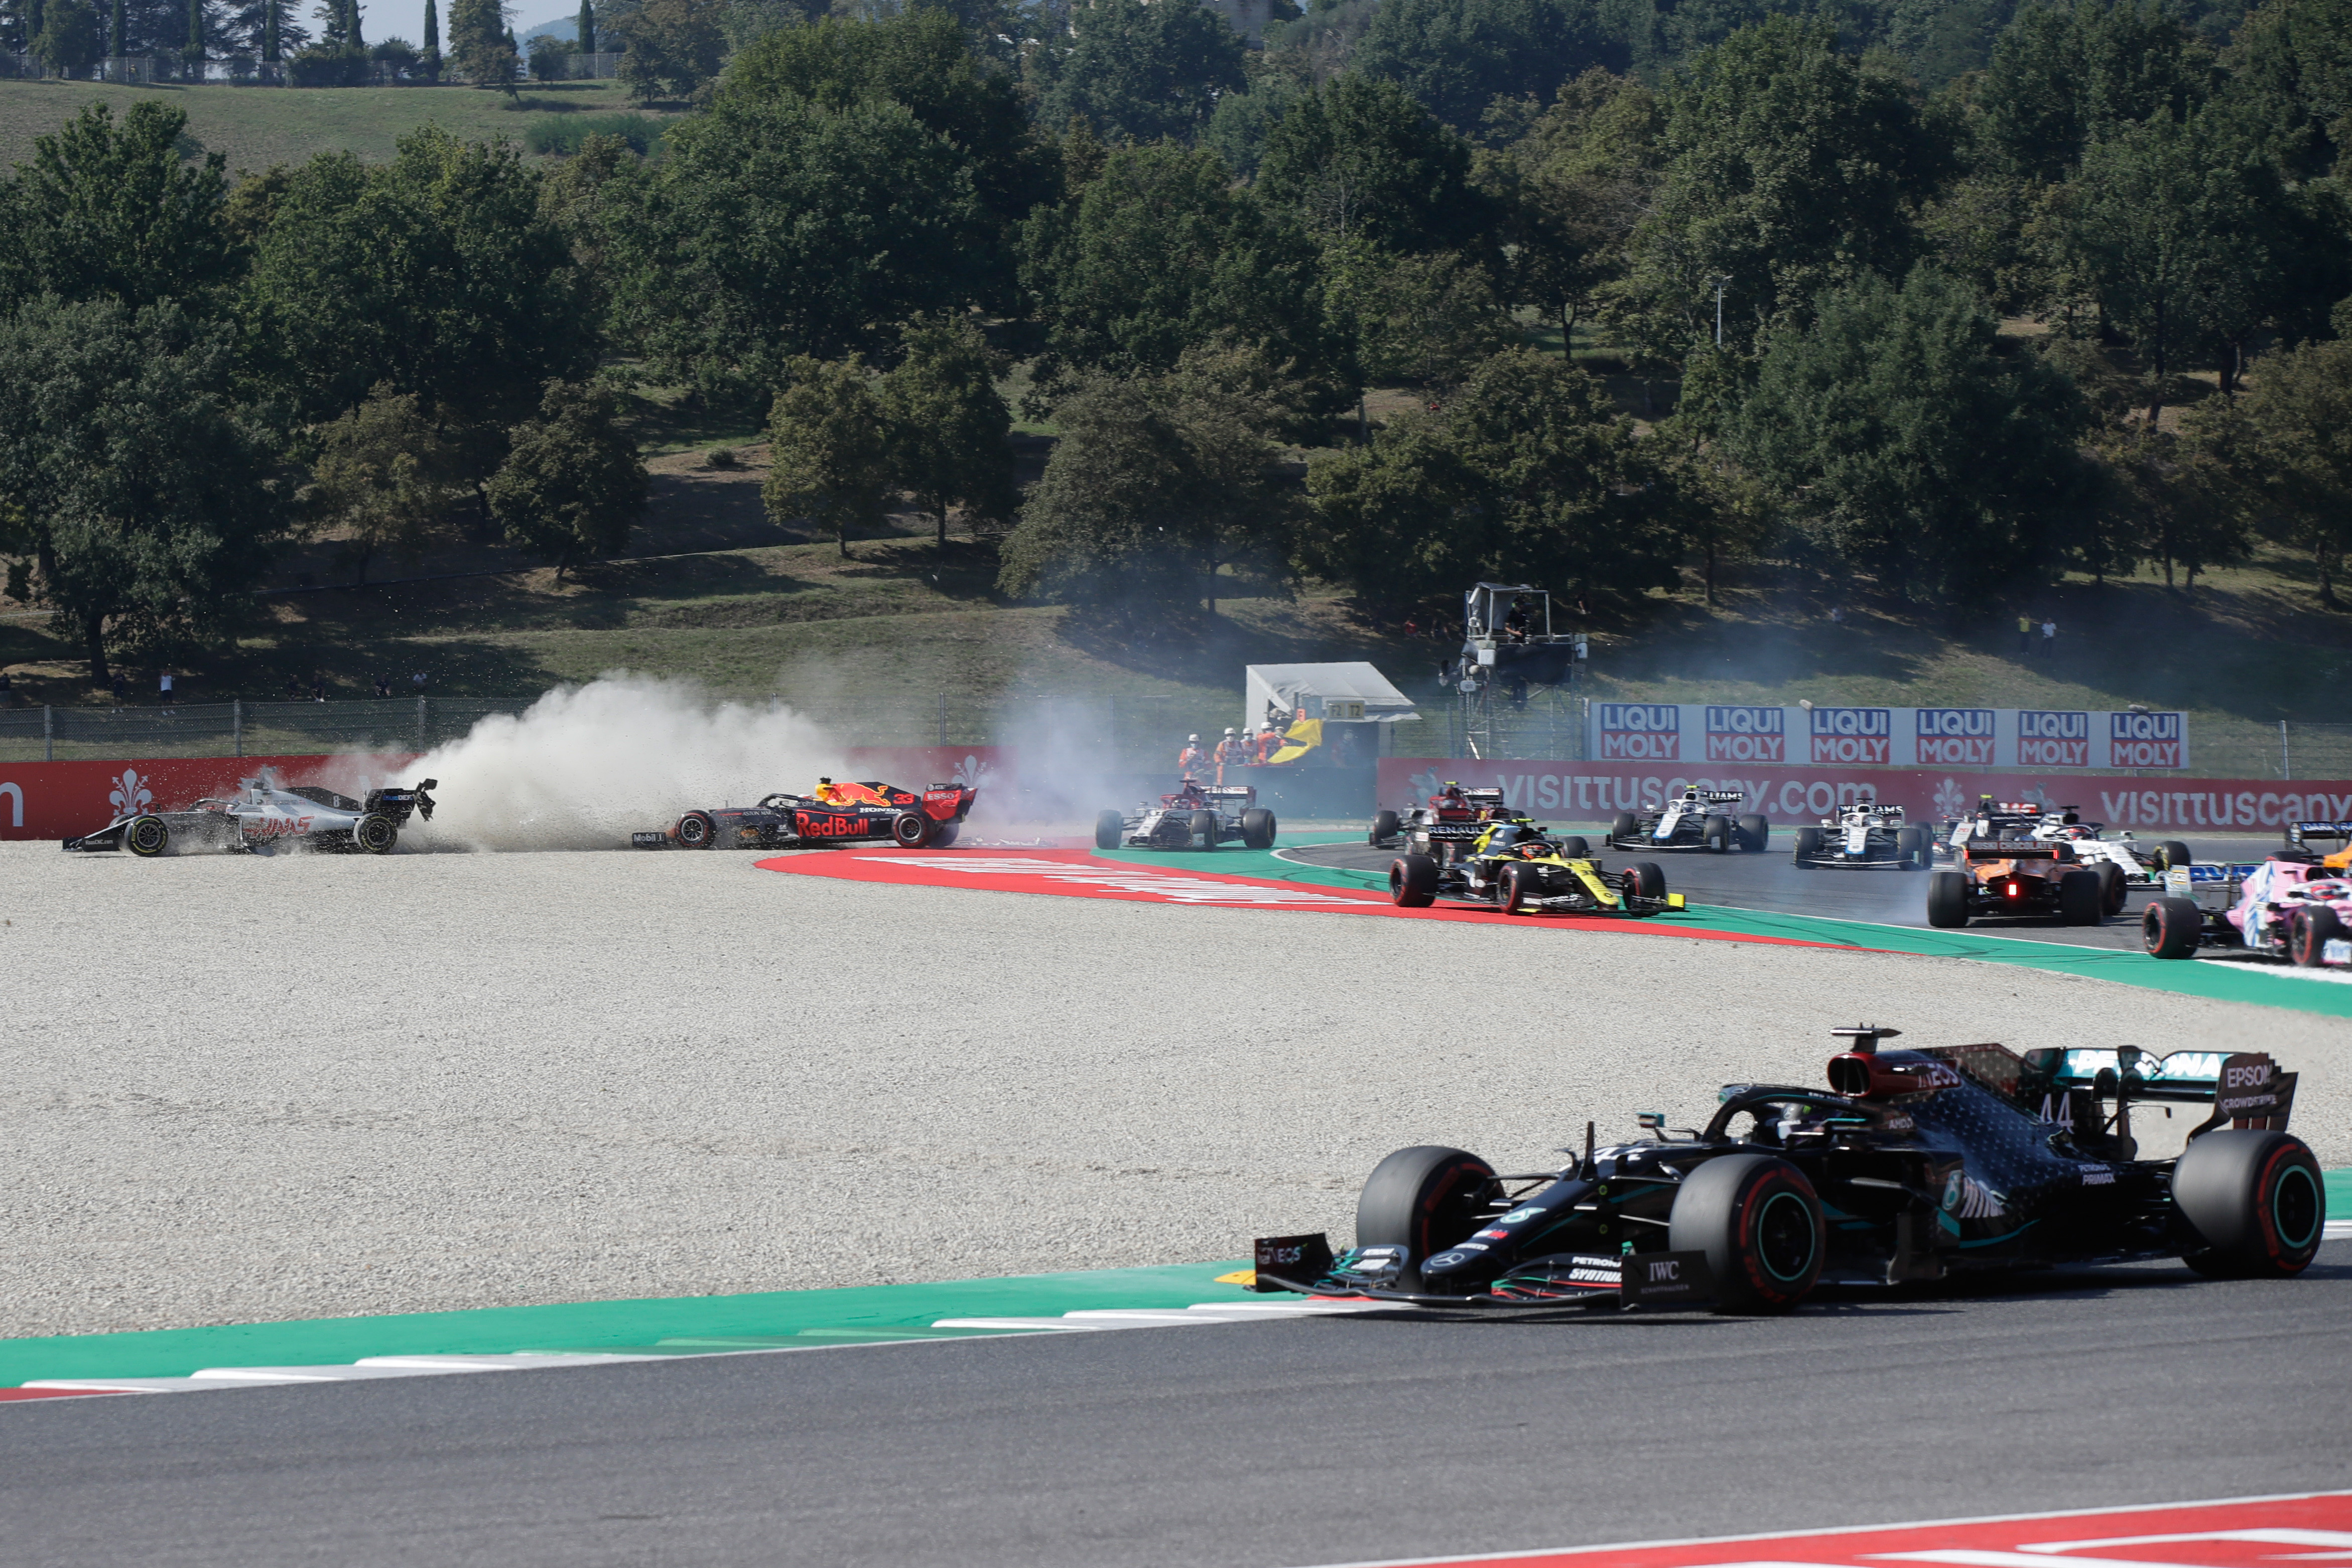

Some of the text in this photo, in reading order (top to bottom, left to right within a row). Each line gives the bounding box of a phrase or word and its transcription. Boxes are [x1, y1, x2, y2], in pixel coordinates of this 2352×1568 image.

[1604, 706, 1676, 731] LIQUI
[1709, 708, 1781, 734] LIQUI
[1813, 710, 1888, 735] LIQUI
[1919, 711, 1993, 736] LIQUI
[2021, 713, 2086, 738] LIQUI
[2113, 715, 2177, 740] LIQUI
[1604, 734, 1678, 758] MOLY
[1710, 735, 1783, 760] MOLY
[1813, 738, 1889, 762] MOLY
[1919, 738, 1995, 762] MOLY
[2021, 740, 2087, 764] MOLY
[2114, 742, 2179, 765] MOLY
[333, 795, 340, 808] 8
[893, 794, 914, 805] 33
[242, 815, 316, 838] HAAS
[796, 812, 869, 837] Red Bull
[1428, 826, 1489, 834] RENAULT
[633, 833, 656, 843] Mobil
[1999, 842, 2054, 850] CHOCOLATE
[2227, 1064, 2273, 1088] EPSON
[2039, 1091, 2075, 1134] 44
[1649, 1260, 1679, 1282] IWC
